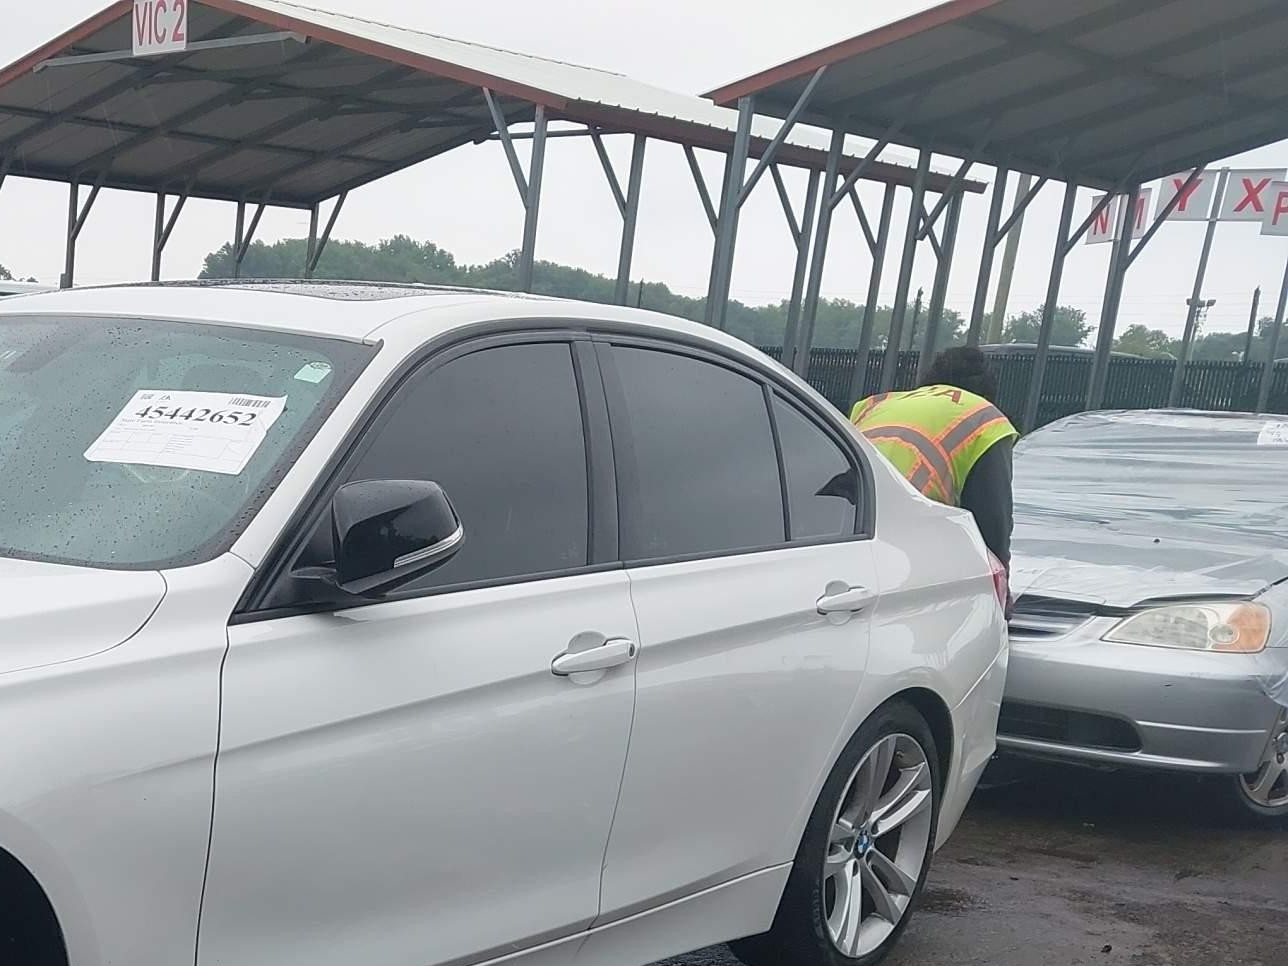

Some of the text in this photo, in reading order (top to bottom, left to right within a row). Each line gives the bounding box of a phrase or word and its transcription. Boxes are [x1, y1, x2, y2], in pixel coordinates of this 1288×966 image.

[135, 0, 184, 46] VIC 2
[1173, 178, 1203, 212] Y
[1233, 178, 1272, 212] X
[135, 404, 258, 427] 45442652
